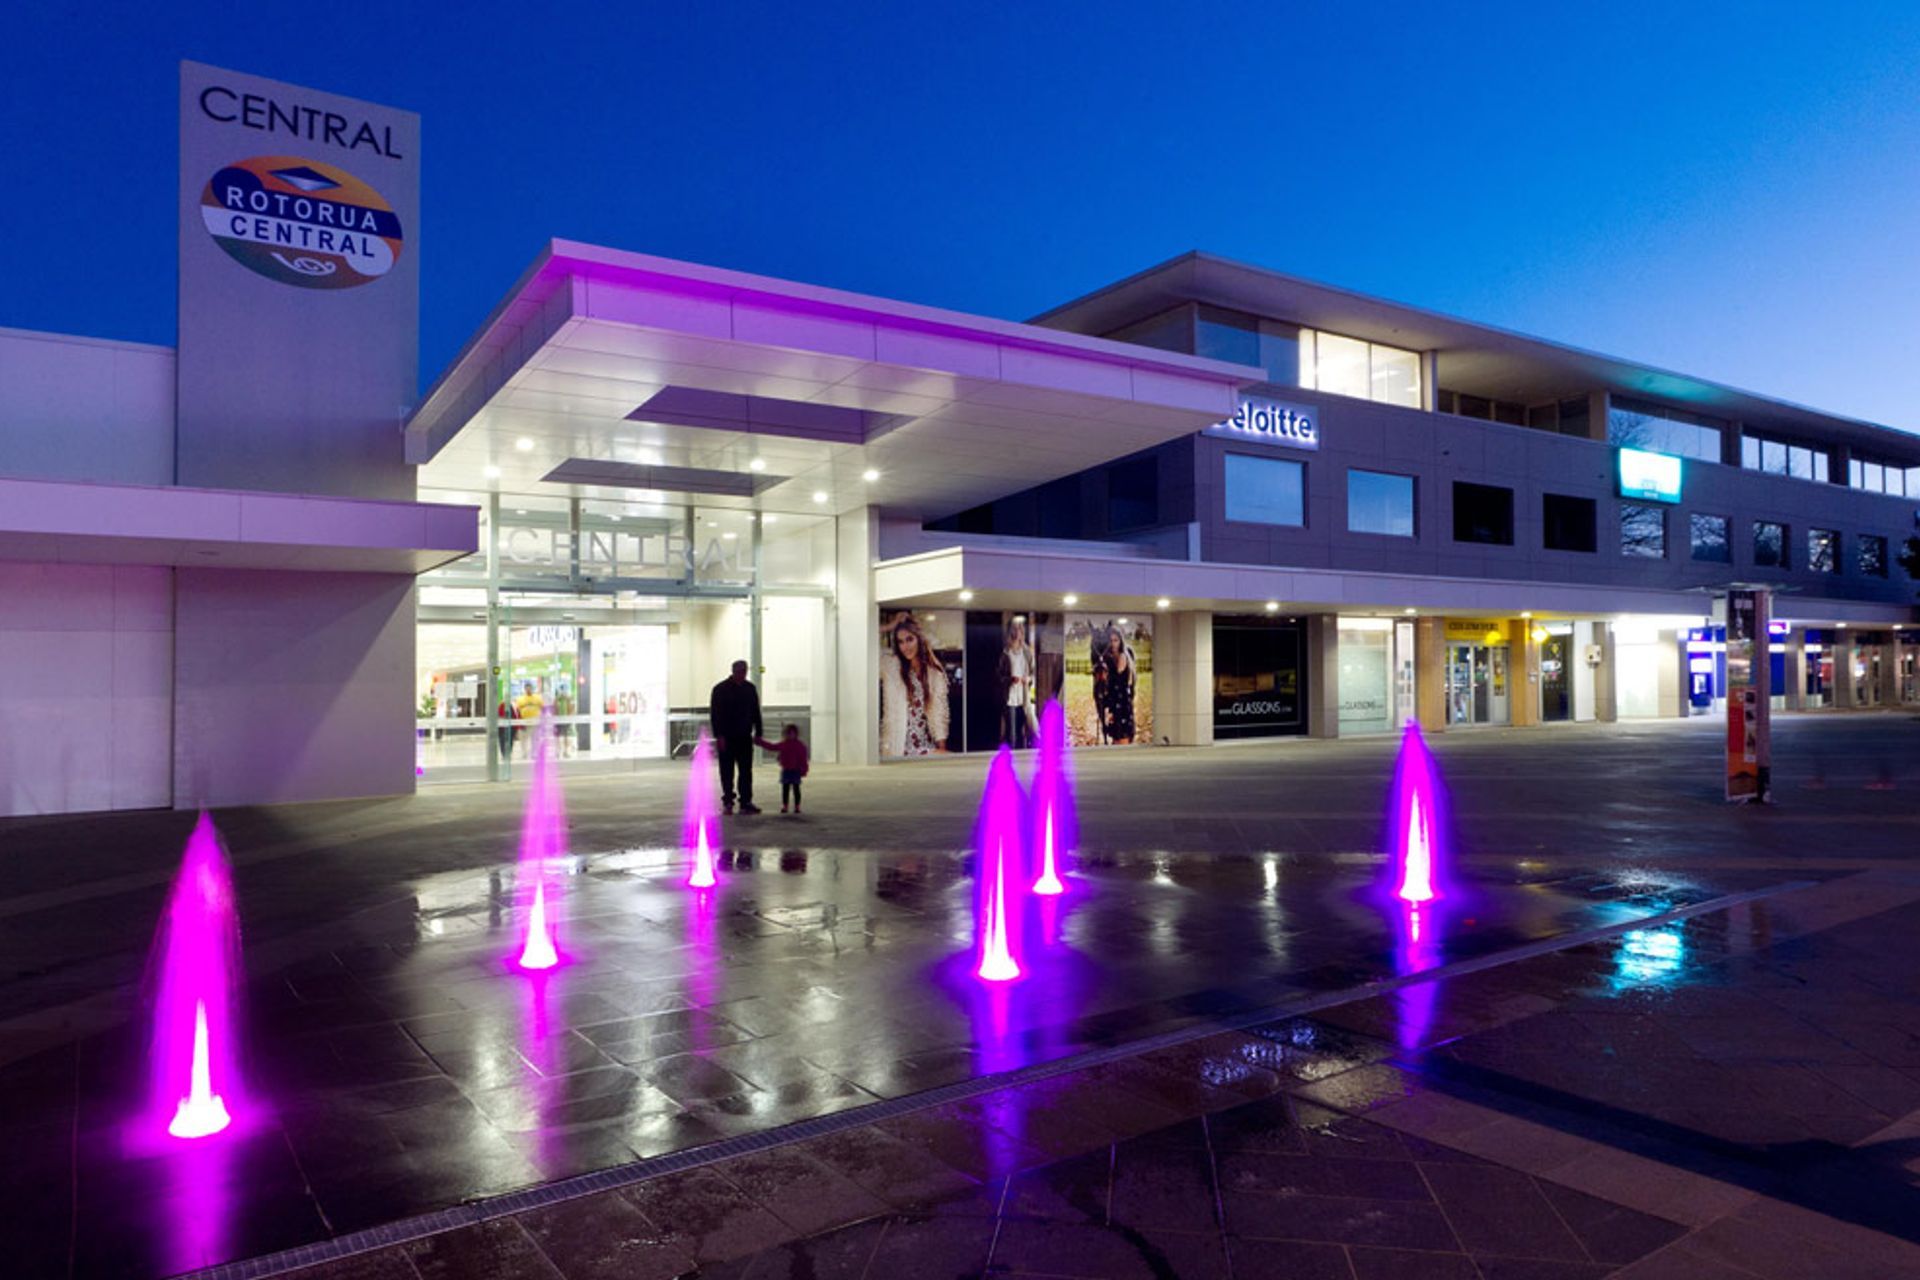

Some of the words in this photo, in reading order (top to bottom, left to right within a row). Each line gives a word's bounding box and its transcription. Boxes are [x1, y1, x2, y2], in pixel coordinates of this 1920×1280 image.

[200, 86, 403, 159] CENTRAL
[226, 185, 378, 232] ROTORUA
[230, 215, 375, 258] CENTRAL
[508, 527, 757, 573] CENTRAL
